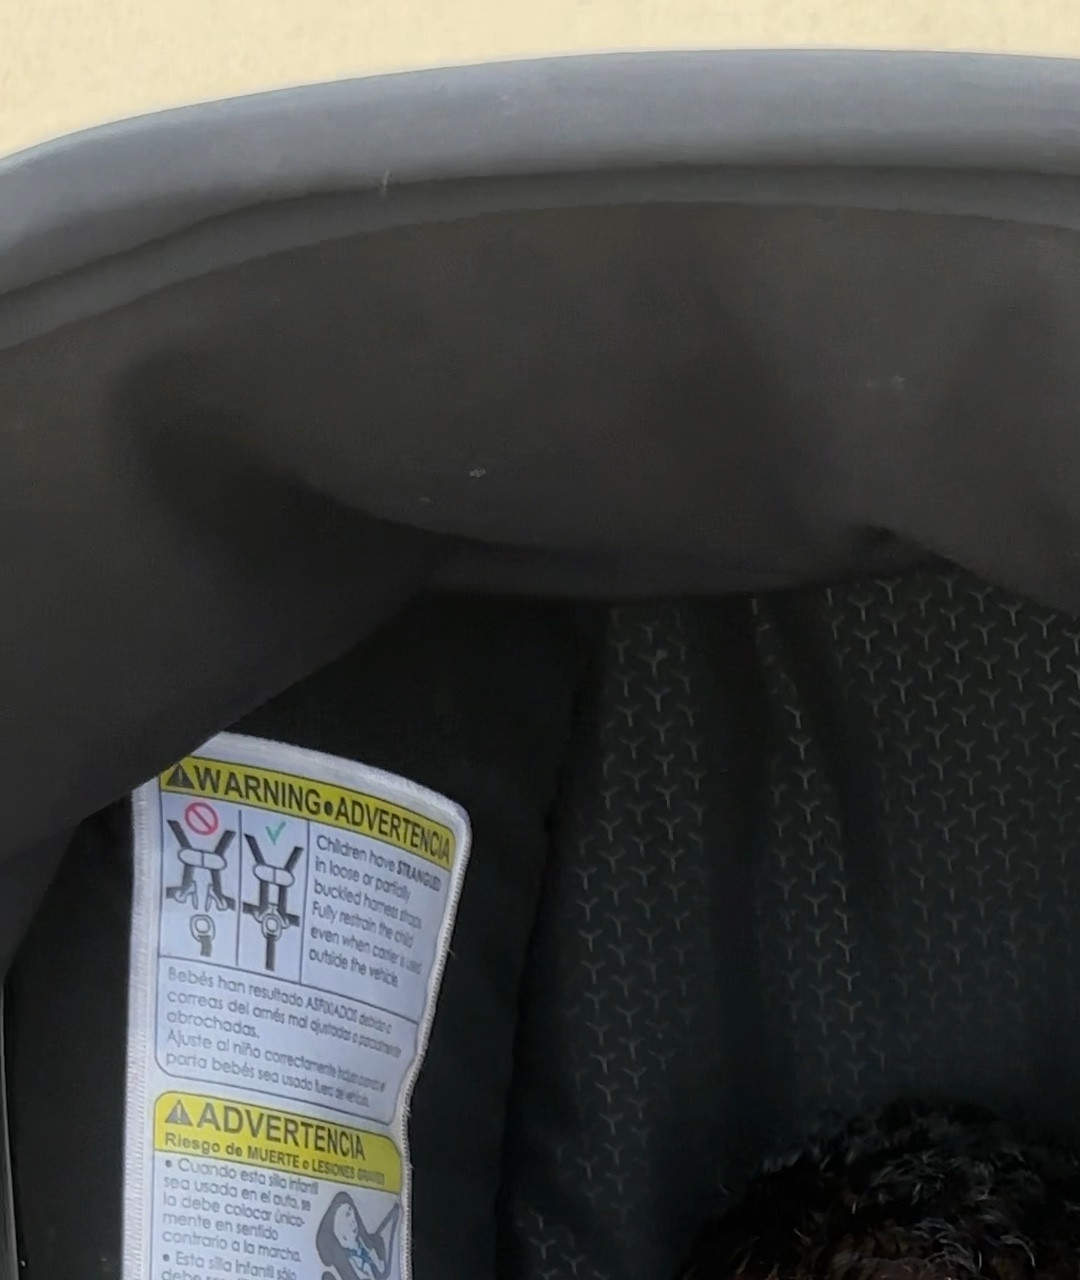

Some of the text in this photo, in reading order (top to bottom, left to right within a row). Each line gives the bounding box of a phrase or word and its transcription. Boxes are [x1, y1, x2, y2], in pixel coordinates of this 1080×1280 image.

[194, 765, 450, 862] WARNING ADVERTENCIA
[316, 835, 366, 863] Children
[369, 850, 395, 872] have
[315, 856, 373, 885] in loose or
[314, 879, 361, 906] buckled
[312, 901, 337, 924] Fully
[310, 926, 339, 942] even
[309, 949, 348, 969] outside
[168, 966, 303, 1007] Bebés han resultado
[167, 991, 249, 1015] correas del
[167, 1029, 212, 1049] Ajuste
[216, 1039, 230, 1052] al
[233, 1042, 261, 1059] niño
[166, 1053, 279, 1083] porta bebés sea
[197, 1103, 366, 1161] ADVERTENCIA
[164, 1132, 221, 1155] Riesgo
[225, 1143, 243, 1157] de
[247, 1146, 299, 1169] MUERTE
[178, 1158, 266, 1185] Cuando esta
[163, 1176, 257, 1200] sea usada en
[181, 1195, 272, 1221] debe colocar
[162, 1213, 233, 1232] mente en
[162, 1231, 228, 1250] contrario
[176, 1251, 205, 1269] Esta
